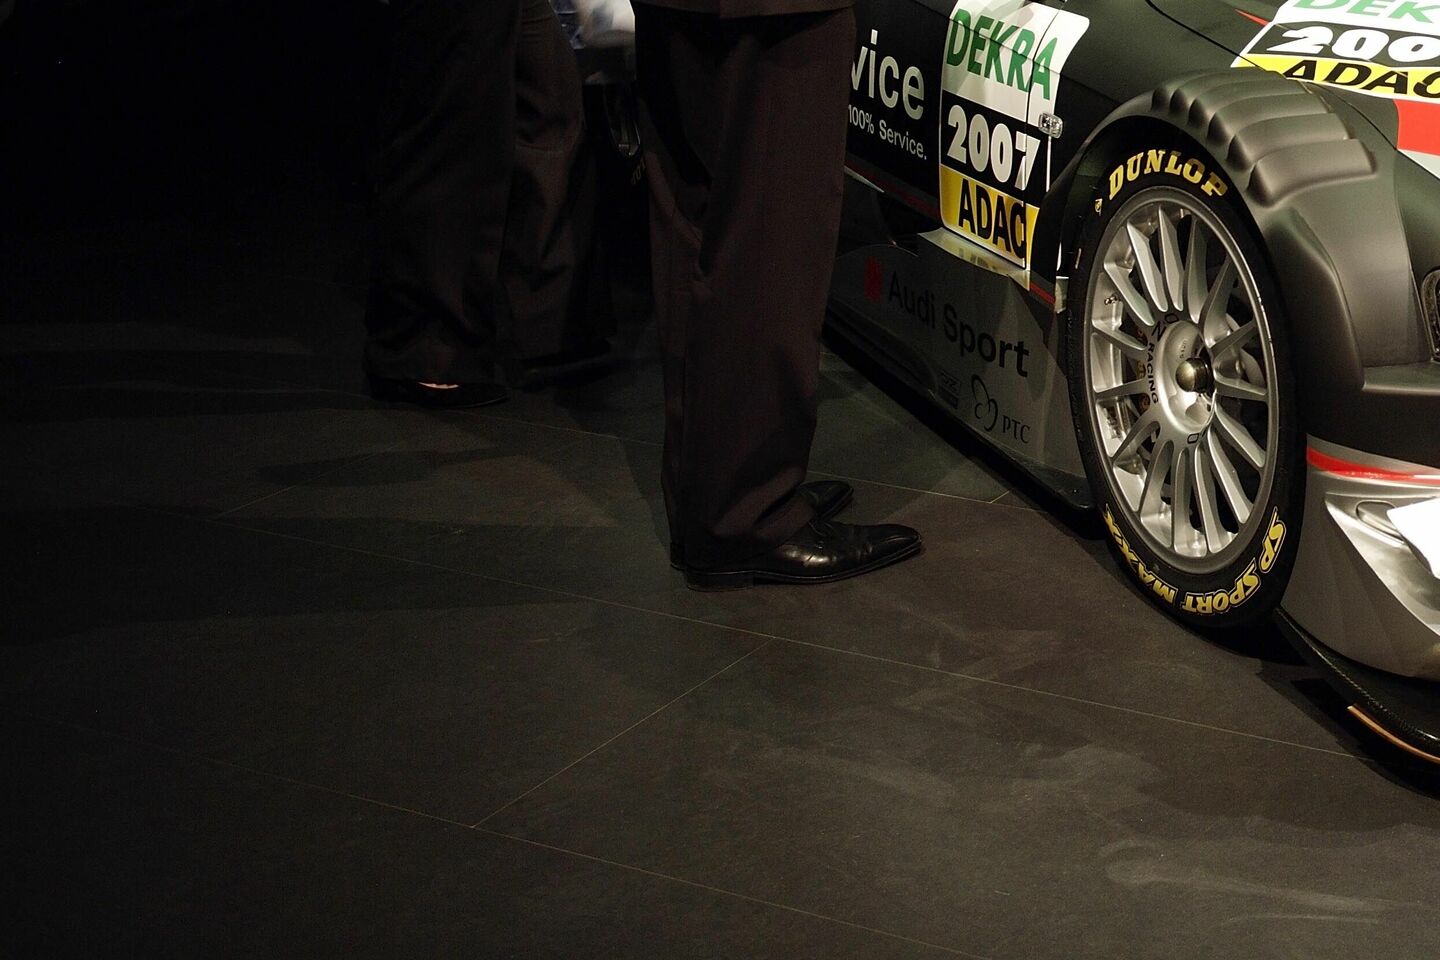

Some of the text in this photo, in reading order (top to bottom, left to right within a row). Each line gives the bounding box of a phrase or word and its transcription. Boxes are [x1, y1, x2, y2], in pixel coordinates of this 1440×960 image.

[851, 28, 925, 121] vice
[946, 8, 1058, 101] DEKRA
[848, 103, 928, 162] 100% Service.
[946, 104, 1041, 192] 2007
[1109, 148, 1229, 200] DUNLOP
[958, 178, 1026, 260] ADAC
[889, 272, 1030, 377] Audi Sport
[1003, 415, 1031, 444] PTC
[1259, 505, 1287, 574] SP
[1181, 557, 1262, 616] SPORT
